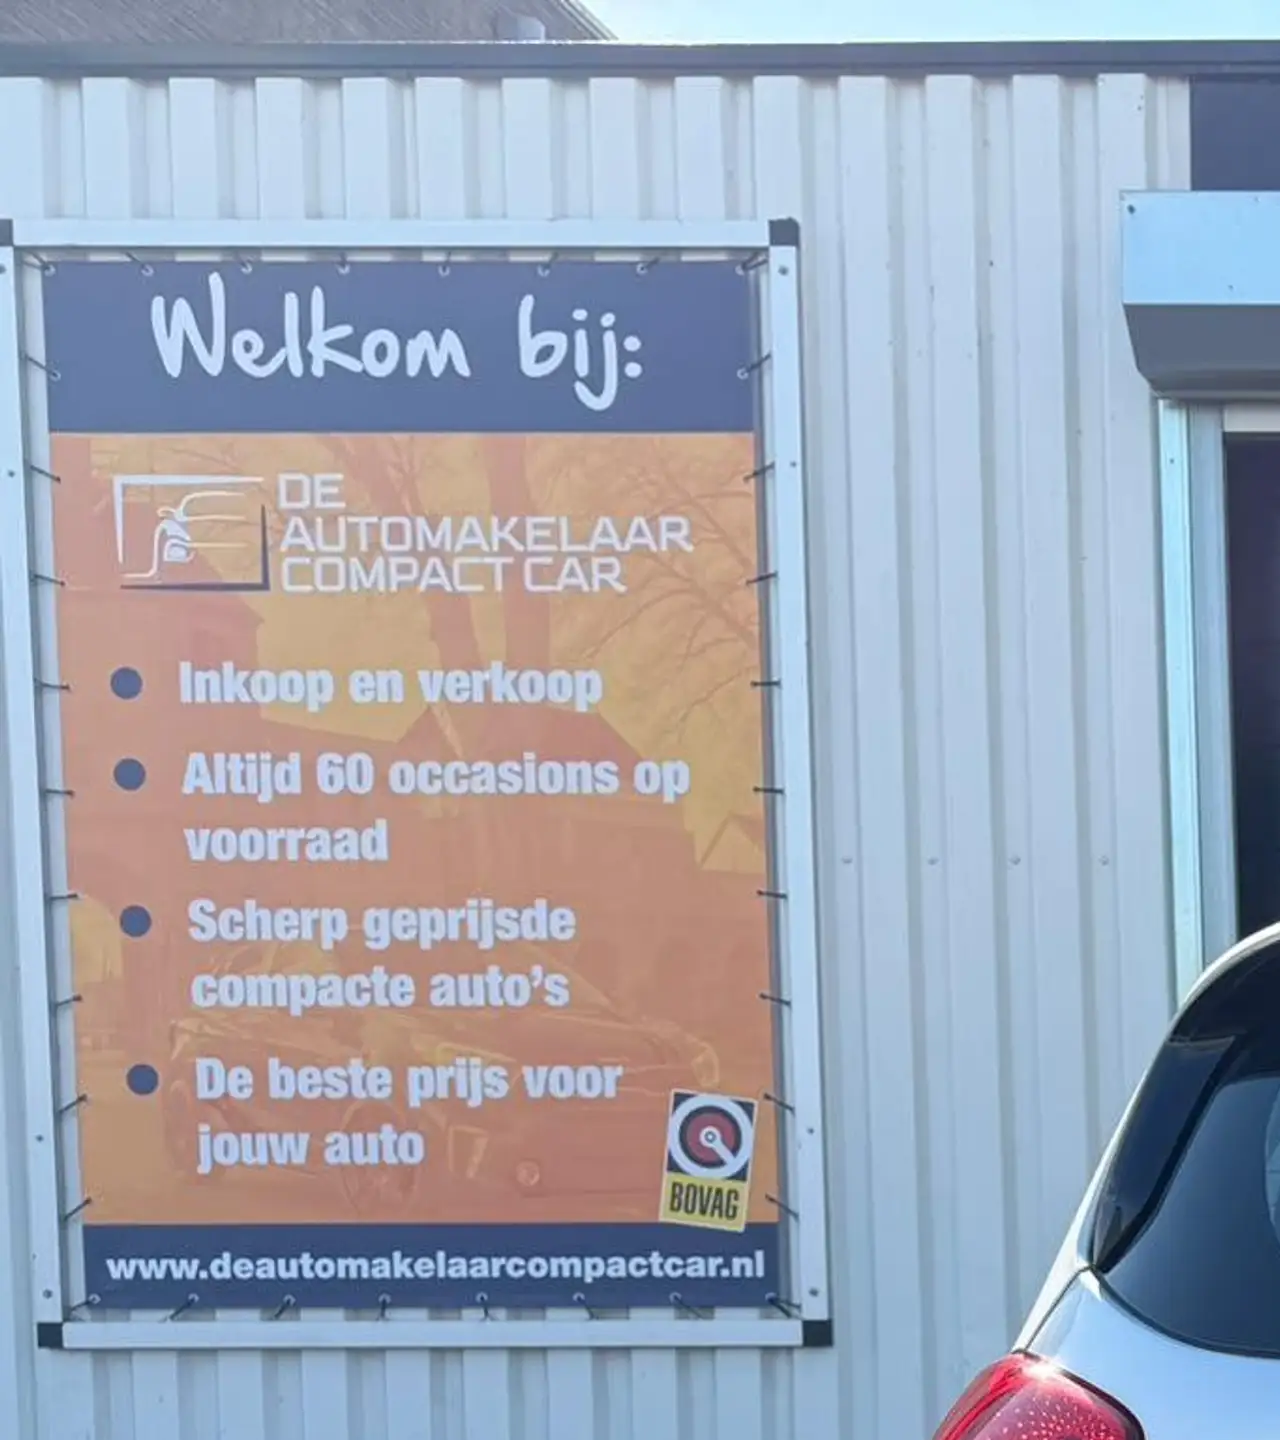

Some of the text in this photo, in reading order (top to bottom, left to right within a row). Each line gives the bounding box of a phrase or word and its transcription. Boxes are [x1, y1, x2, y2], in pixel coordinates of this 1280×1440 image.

[150, 271, 643, 411] Welkom bij:
[278, 473, 346, 510] DE
[279, 515, 694, 554] AUTOMAKELAAR
[280, 556, 629, 593] COMPACT CAR
[179, 660, 603, 713] Inkoop en verkoop
[181, 751, 690, 804] Altijd 60 occasions op
[183, 818, 389, 863] voorraad
[187, 898, 576, 949] Scherp geprijsde
[190, 964, 570, 1017] compacte auto's
[195, 1057, 624, 1109] De beste prijs voor
[197, 1123, 425, 1175] jouw auto
[668, 1181, 740, 1221] BOVAG
[105, 1250, 765, 1284] www.deautomakelaarcompactcar.nl
